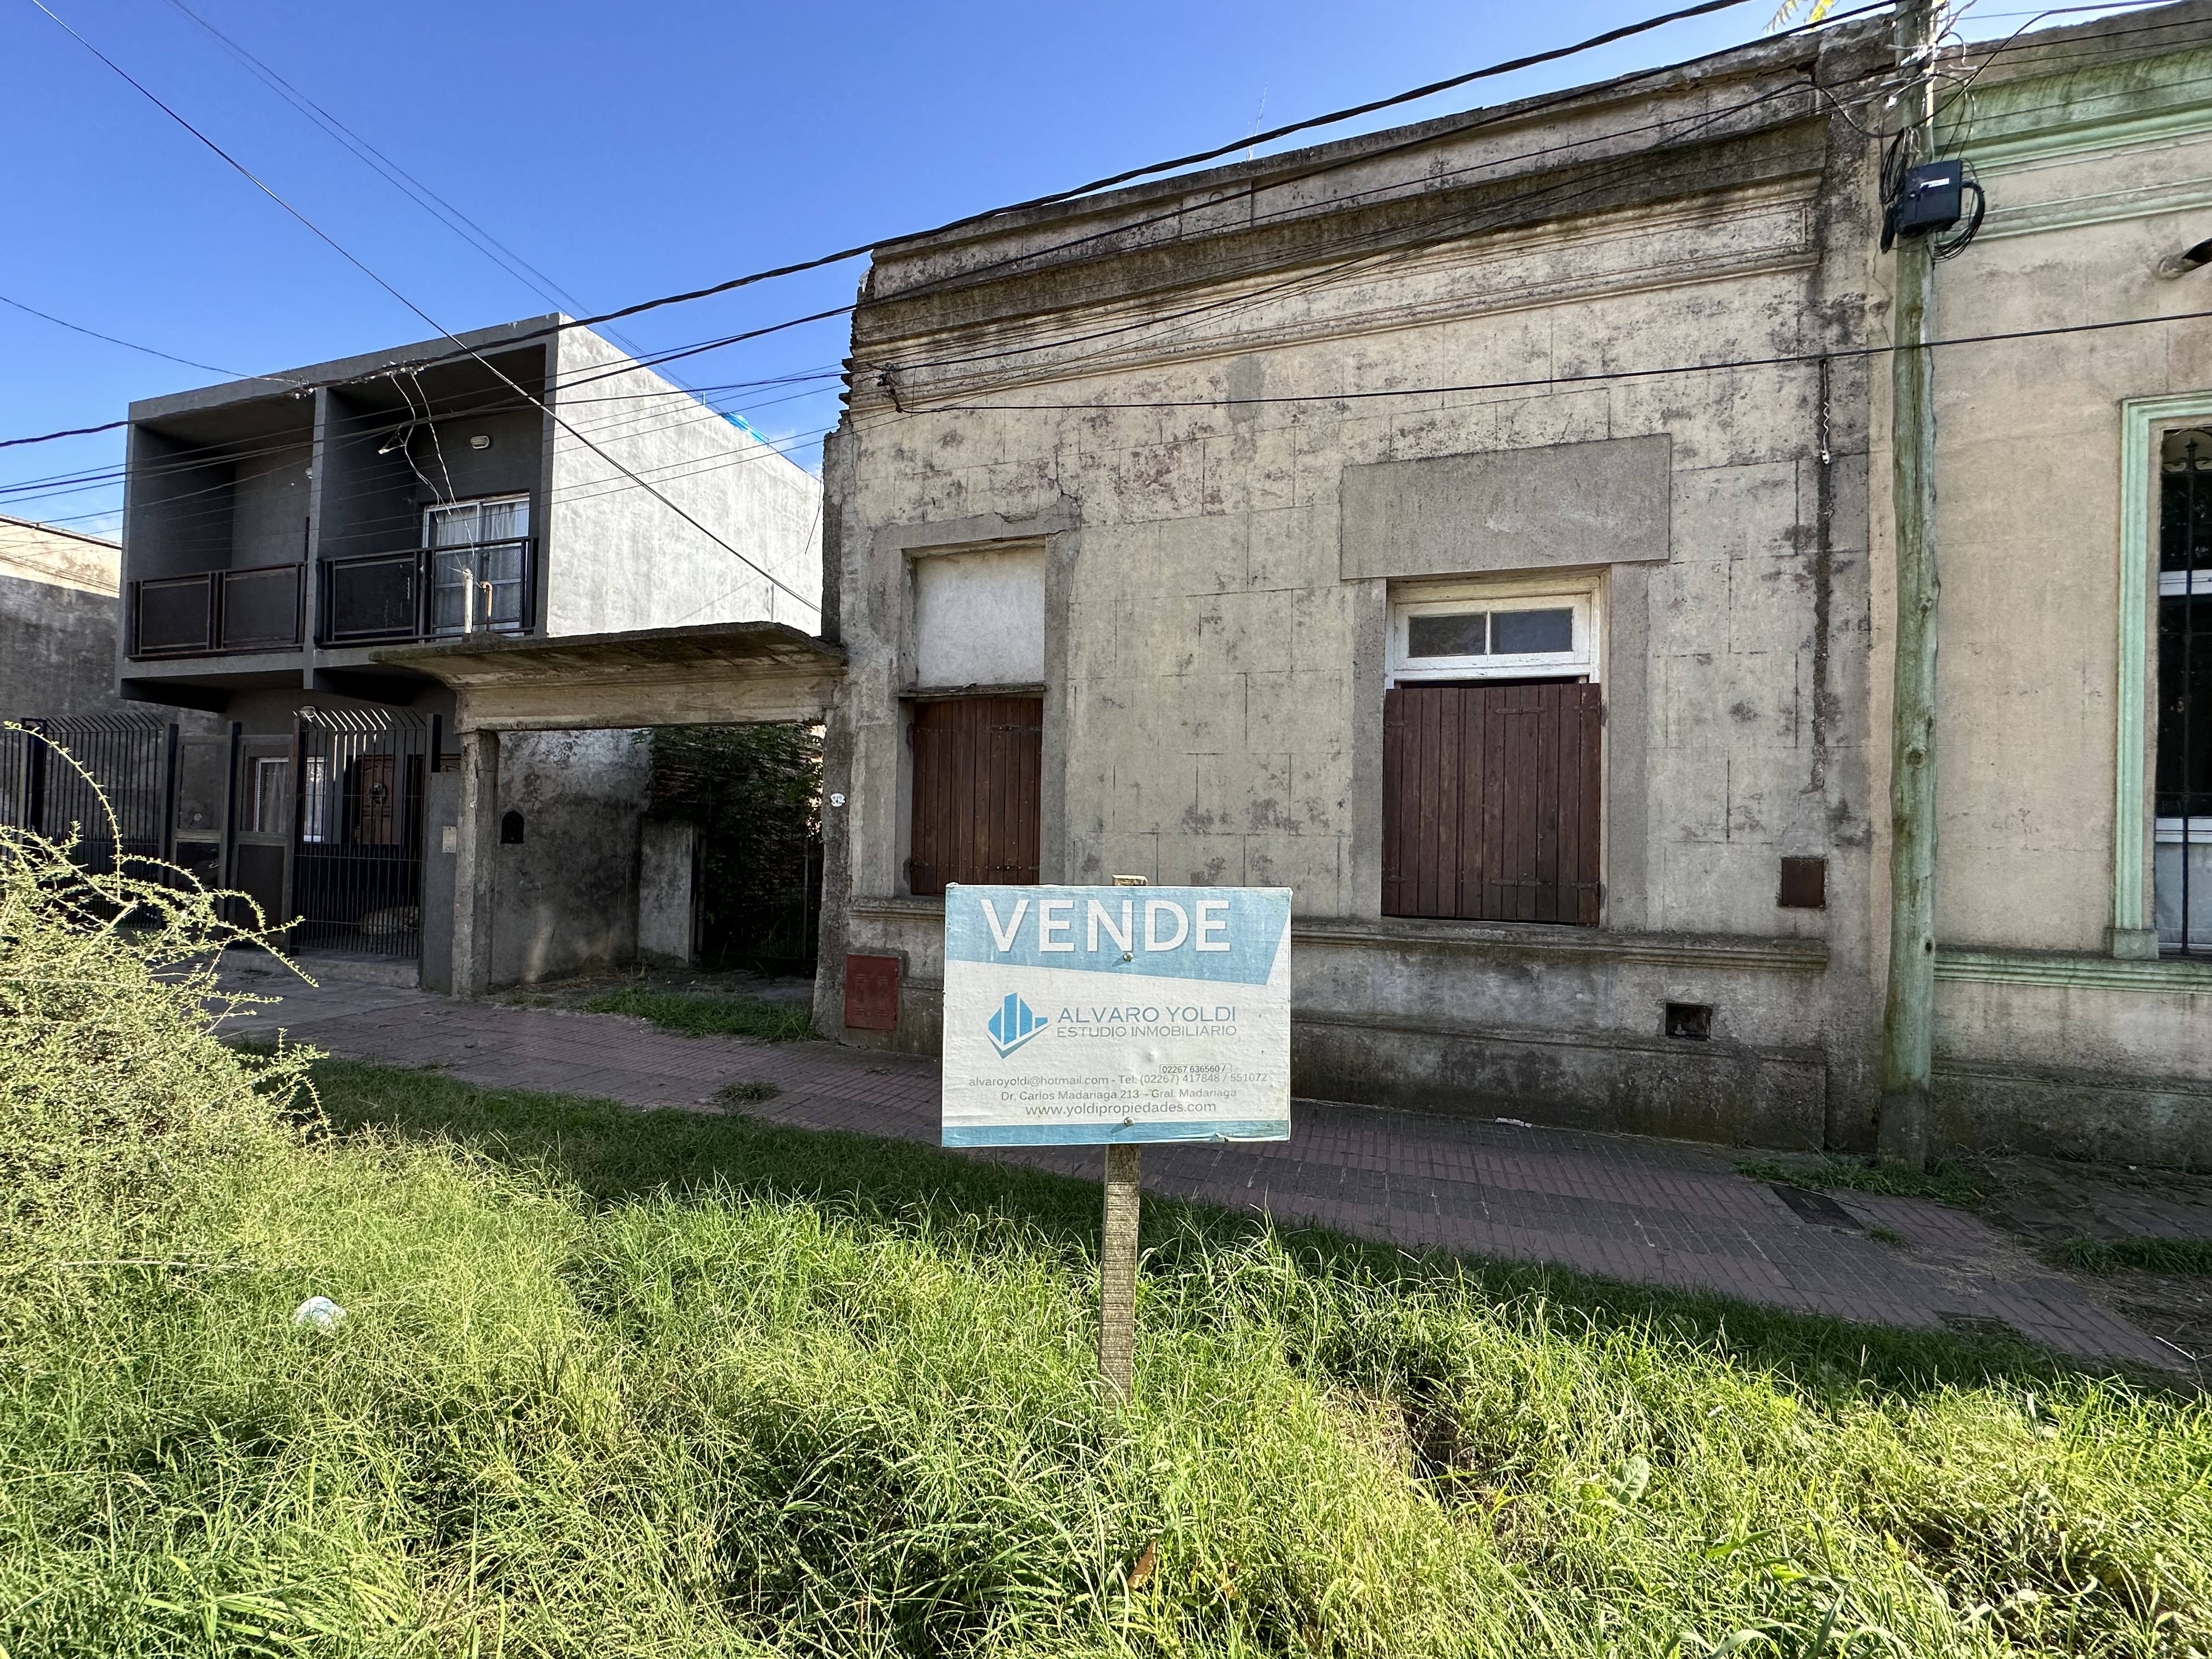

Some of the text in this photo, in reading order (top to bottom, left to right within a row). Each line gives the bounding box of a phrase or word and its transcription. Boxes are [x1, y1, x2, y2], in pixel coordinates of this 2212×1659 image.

[980, 899, 1231, 952] VENDE
[1057, 1006, 1237, 1024] ALVARO YOLDI
[1057, 1025, 1237, 1037] ESTUDIO INMOBILIARIO
[1189, 1065, 1220, 1073] 636560
[969, 1075, 1109, 1088] alvaroyoldi@hotmail.com
[1118, 1075, 1137, 1084] Tel:
[1140, 1074, 1180, 1085] (02267)
[1182, 1074, 1220, 1083] 417848
[1230, 1073, 1267, 1082] 551072
[1001, 1091, 1016, 1101] Dr.
[1019, 1091, 1055, 1100] Carlos
[1058, 1090, 1117, 1101] Madariaga
[1120, 1090, 1139, 1099] 213
[1152, 1089, 1175, 1098] Gral.
[1180, 1088, 1237, 1099] Madariaga
[1025, 1102, 1216, 1117] www.yoldipropiedades.com
